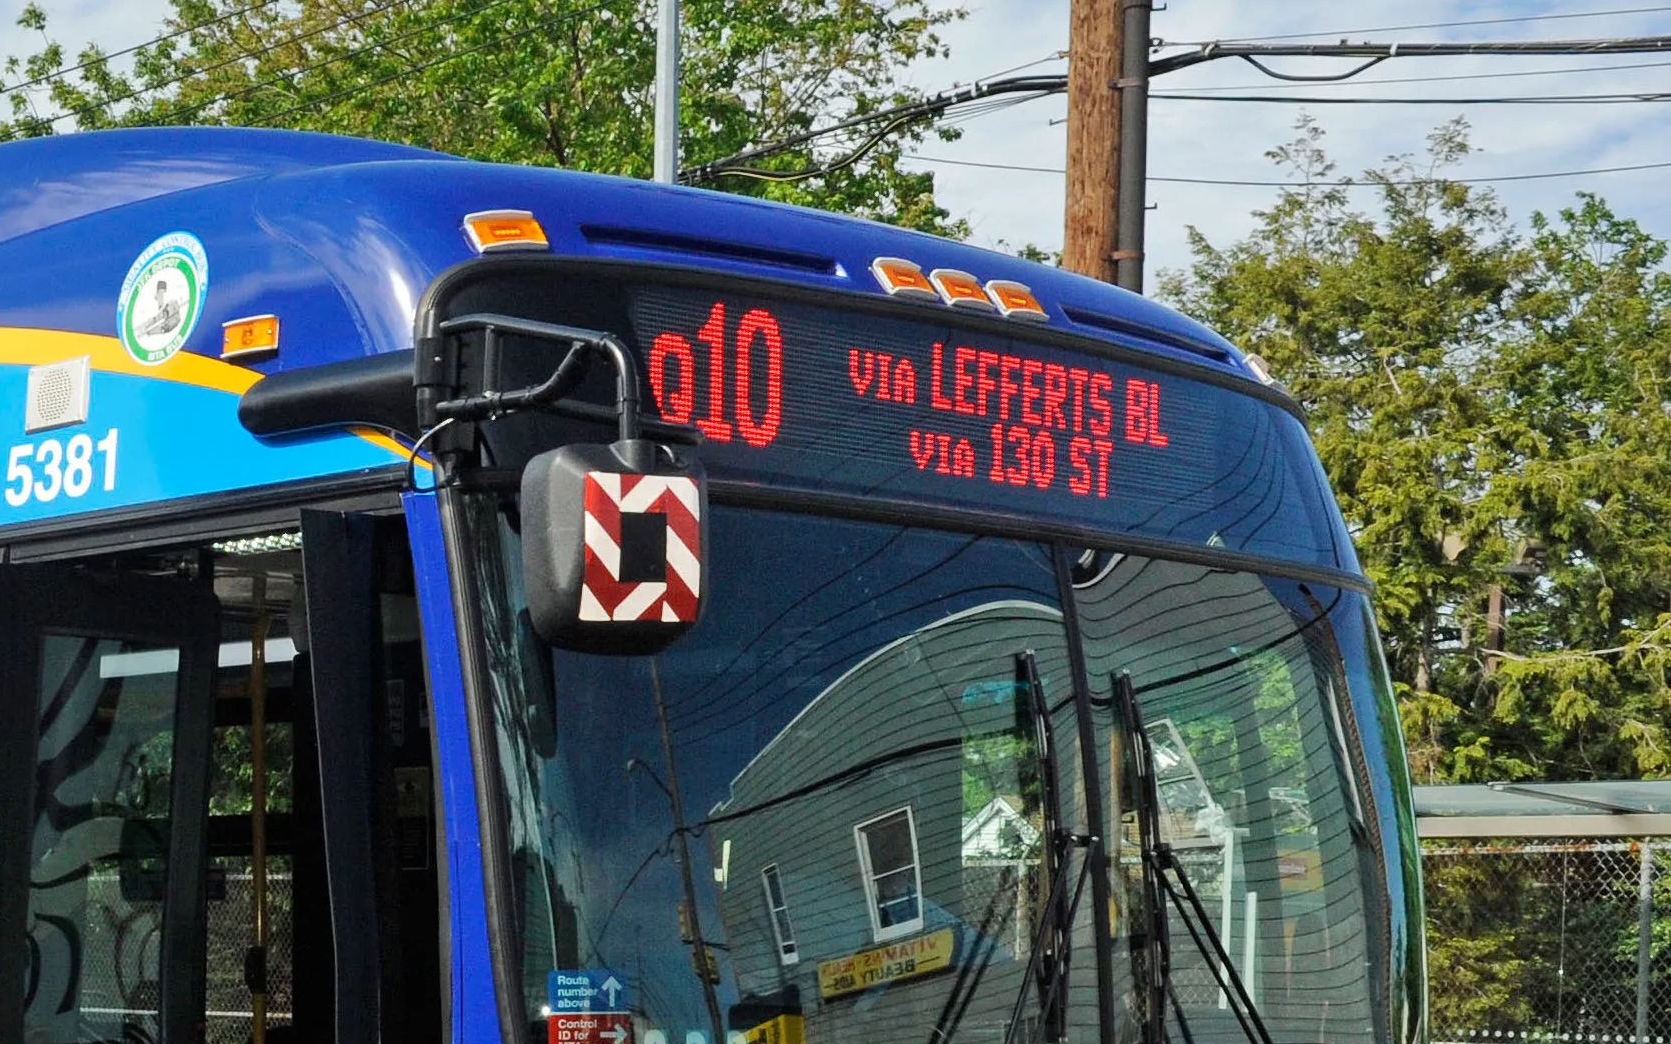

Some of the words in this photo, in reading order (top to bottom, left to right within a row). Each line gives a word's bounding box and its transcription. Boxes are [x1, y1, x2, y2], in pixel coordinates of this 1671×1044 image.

[649, 302, 783, 448] Q10
[931, 342, 1113, 437] LEFFERTS
[1126, 379, 1169, 447] BL
[989, 423, 1057, 489] 130
[1069, 437, 1114, 498] ST
[4, 427, 119, 507] 5381
[557, 975, 590, 985] Route
[557, 988, 598, 997] number
[557, 998, 591, 1008] above
[557, 1018, 597, 1029] Control
[558, 1030, 571, 1041] ID
[574, 1030, 589, 1040] for
